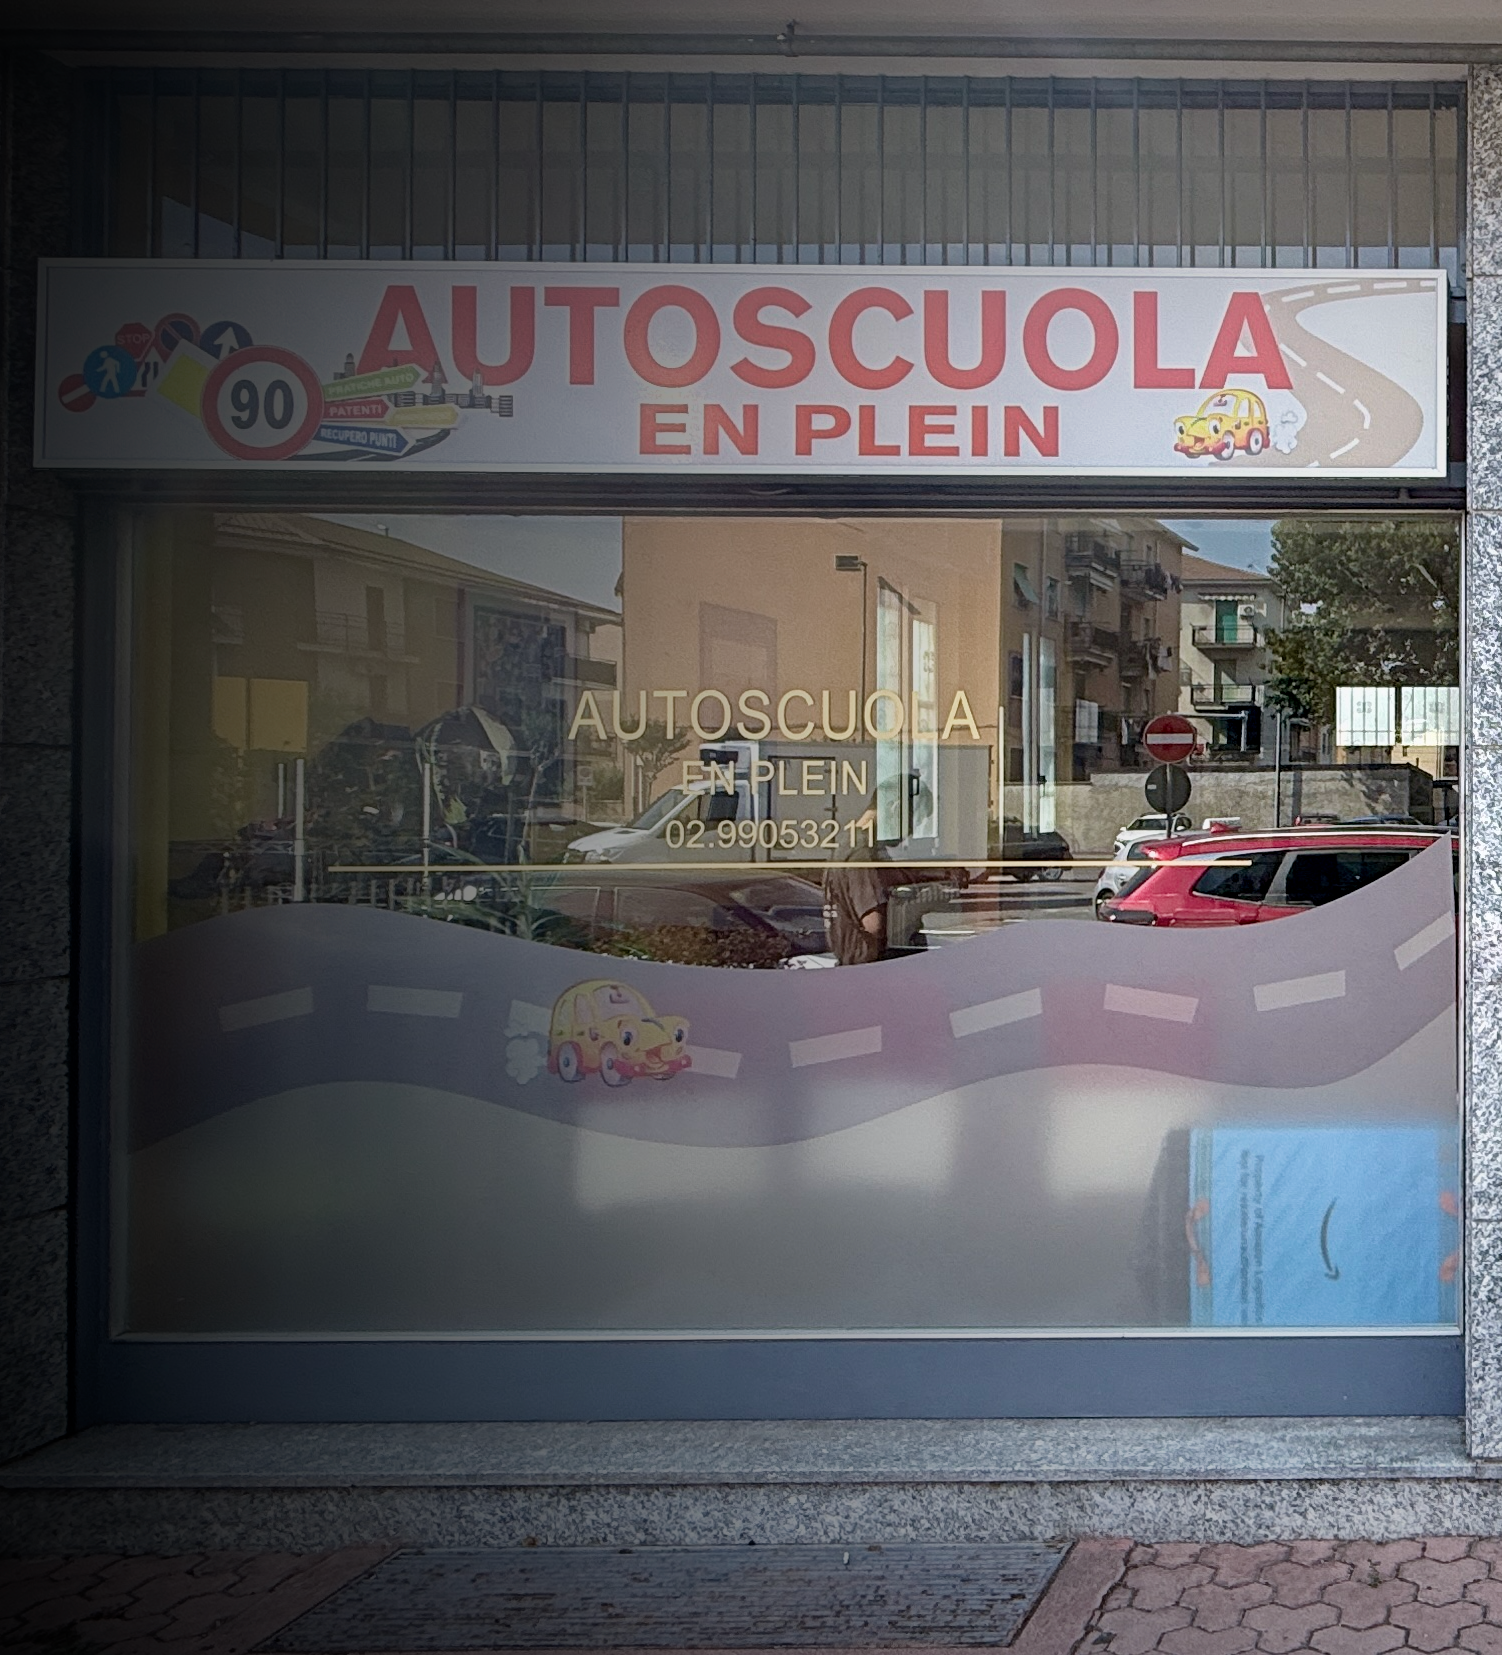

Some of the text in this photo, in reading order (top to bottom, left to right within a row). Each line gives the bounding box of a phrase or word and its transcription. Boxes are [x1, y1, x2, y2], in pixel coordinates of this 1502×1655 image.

[116, 333, 150, 345] STOP
[357, 285, 1293, 391] AUTOSCUOLA
[328, 373, 415, 394] PRATICHE AUTO
[230, 378, 294, 430] 90
[329, 404, 382, 417] PATENTI
[320, 428, 397, 448] RECUPERO PUNTI
[639, 403, 1059, 458] EN PLEIN
[568, 689, 982, 741] AUTOSCUOLA
[682, 760, 869, 796] EN PLEIN
[666, 818, 876, 850] 02.99053211
